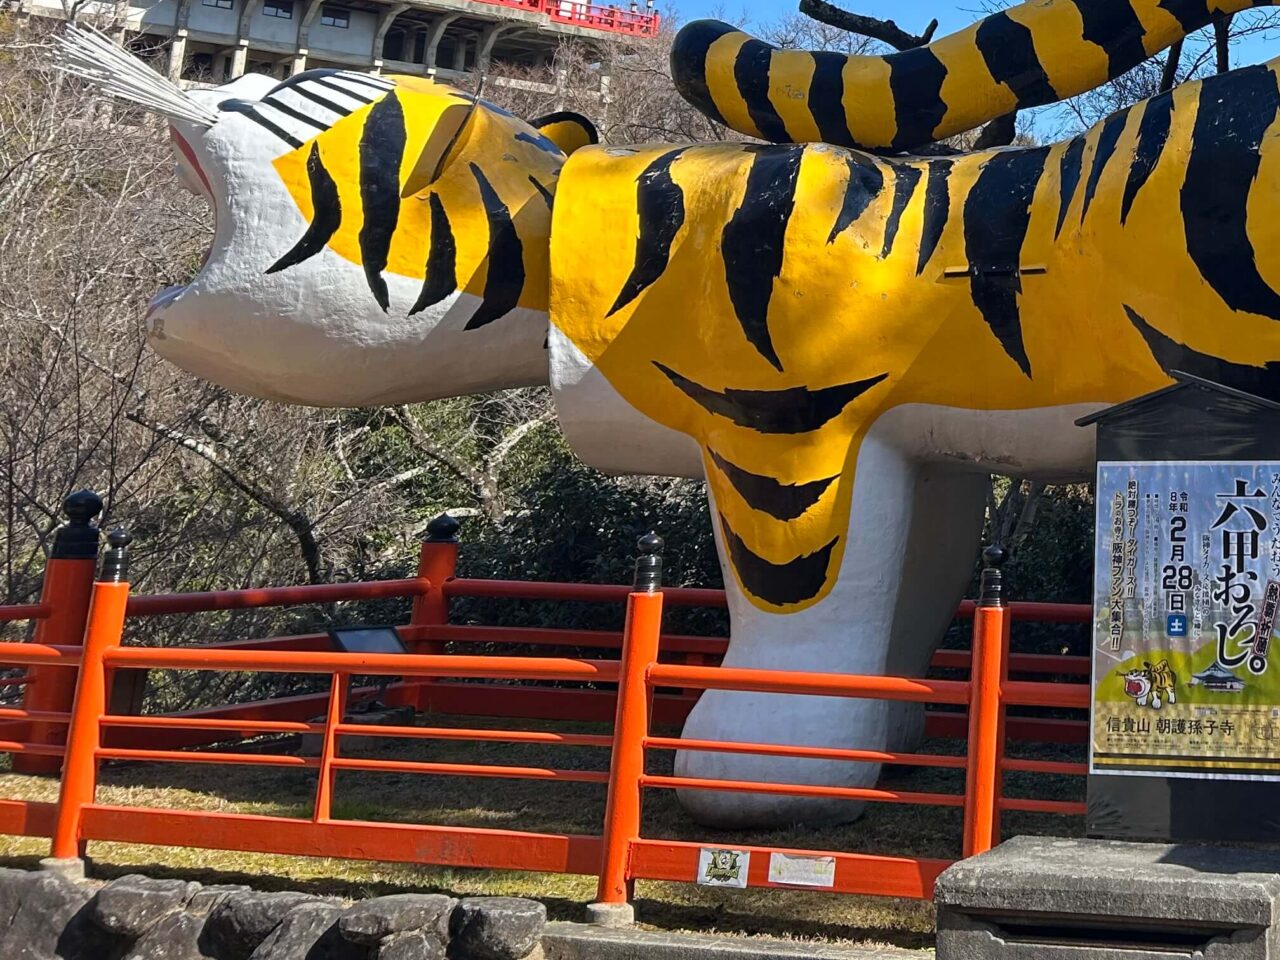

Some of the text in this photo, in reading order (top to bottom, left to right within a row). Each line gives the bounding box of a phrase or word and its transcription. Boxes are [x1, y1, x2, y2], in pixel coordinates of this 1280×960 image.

[1168, 492, 1179, 513] 8年
[1179, 491, 1189, 512] 令和
[1170, 618, 1183, 632] 土
[1105, 716, 1235, 737] 信貴山 朝護孫子寺
